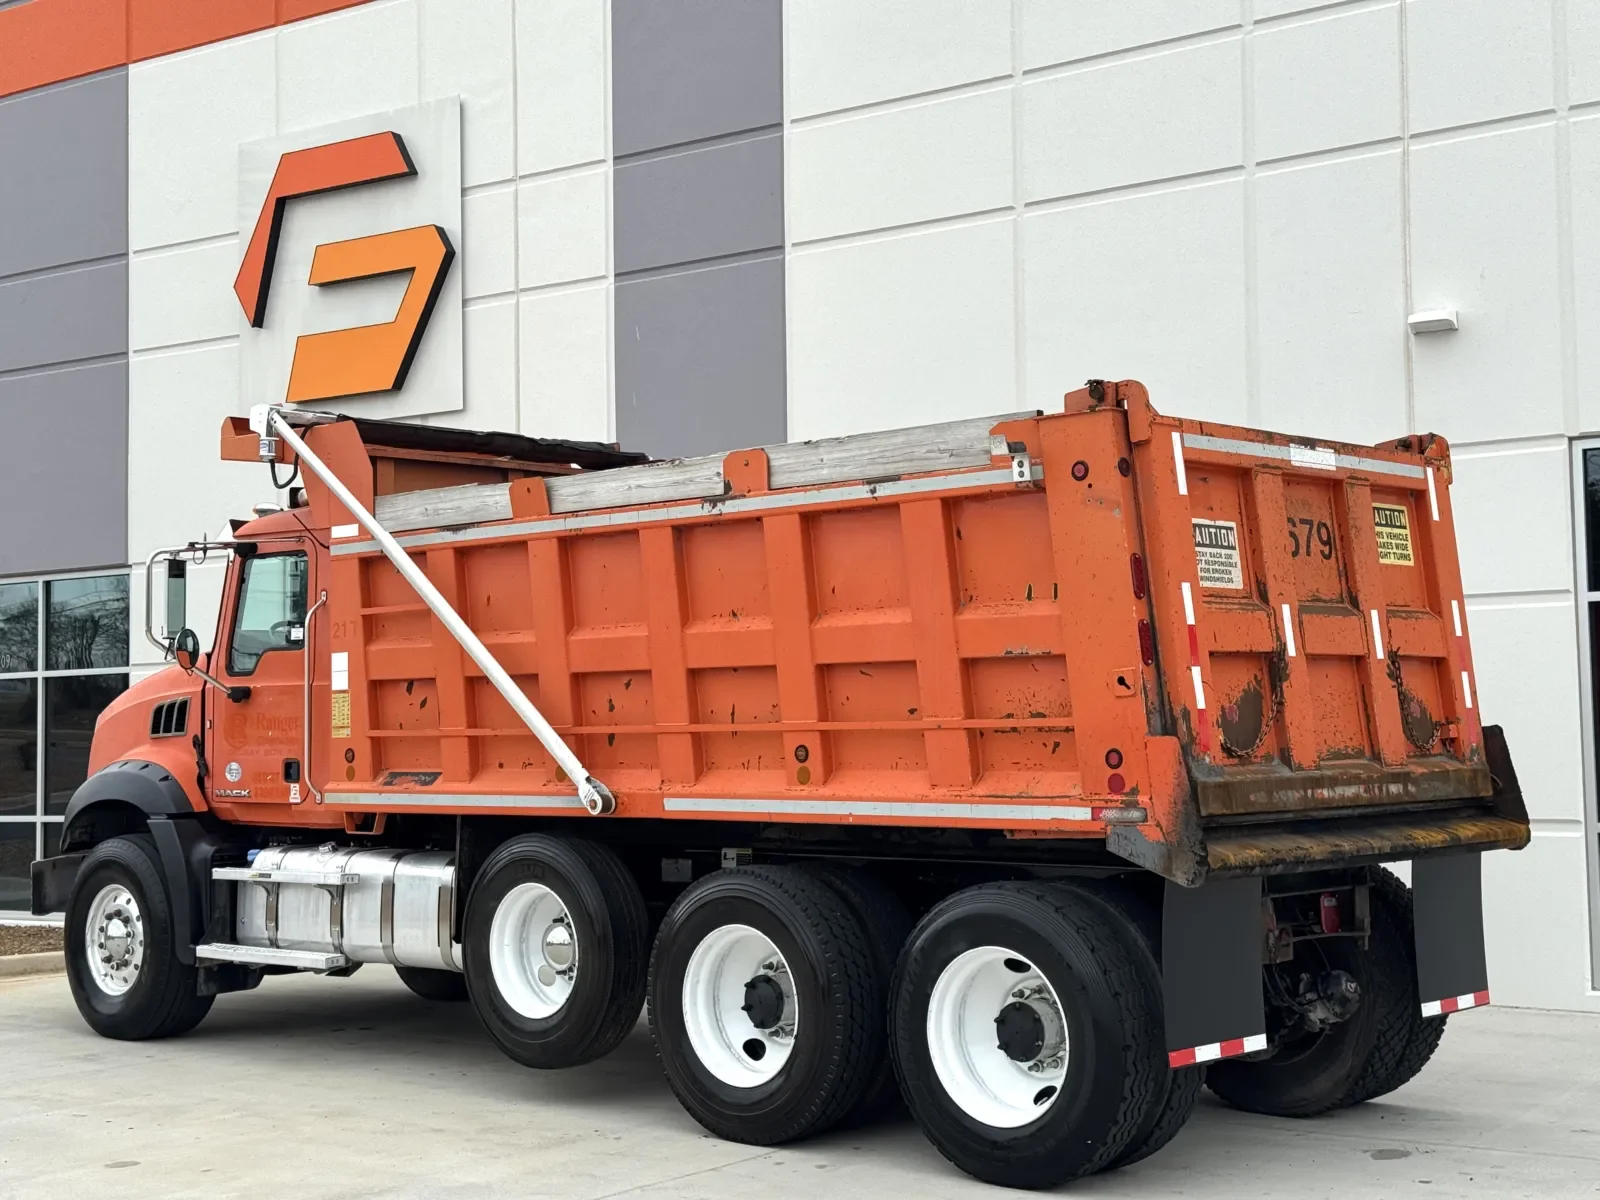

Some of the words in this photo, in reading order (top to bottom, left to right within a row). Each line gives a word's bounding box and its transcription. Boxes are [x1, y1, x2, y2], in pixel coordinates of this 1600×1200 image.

[1374, 509, 1406, 527] AUTION
[1195, 526, 1236, 547] AUTION
[1385, 531, 1409, 542] VEHICLE
[1377, 541, 1394, 550] AKES
[1394, 542, 1409, 552] WIDE
[1208, 551, 1223, 559] BACK
[1380, 551, 1391, 560] GHT
[1392, 551, 1412, 562] TURNS
[1204, 559, 1238, 568] RESPONSIBLE
[1211, 568, 1233, 576] BROKEN
[1200, 575, 1234, 584] WINDSHIELDS
[215, 789, 251, 798] MACK
